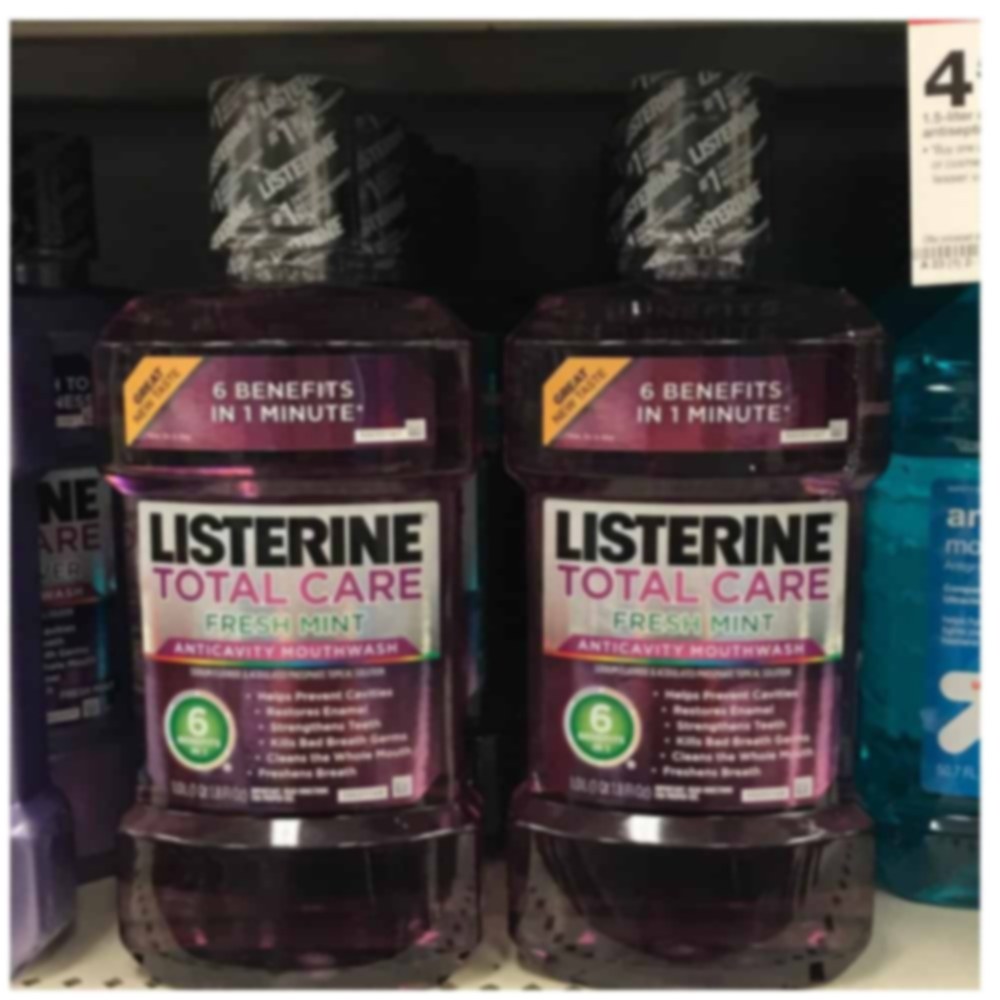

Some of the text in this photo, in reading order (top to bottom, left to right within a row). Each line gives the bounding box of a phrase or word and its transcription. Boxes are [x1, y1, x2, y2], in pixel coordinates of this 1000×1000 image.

[923, 49, 974, 108] 4
[212, 380, 355, 401] 6 BENEFITS
[638, 380, 783, 401] 6 BENEFITS
[210, 403, 235, 423] IN
[243, 404, 253, 423] 1
[636, 404, 661, 424] IN
[670, 404, 679, 424] 1
[149, 512, 423, 568] LISTERINE
[555, 509, 833, 567] LISTERINE
[152, 566, 423, 606] TOTAL CARE
[556, 563, 831, 604] TOTAL CARE
[205, 613, 365, 635] FRESH MINT
[612, 610, 775, 633] FRESH MINT
[173, 641, 399, 660] ANTICAVITY MOUTHWASH
[577, 638, 806, 659] ANTICAVITY MOUTHWASH
[186, 705, 210, 738] 6
[589, 702, 613, 734] 6
